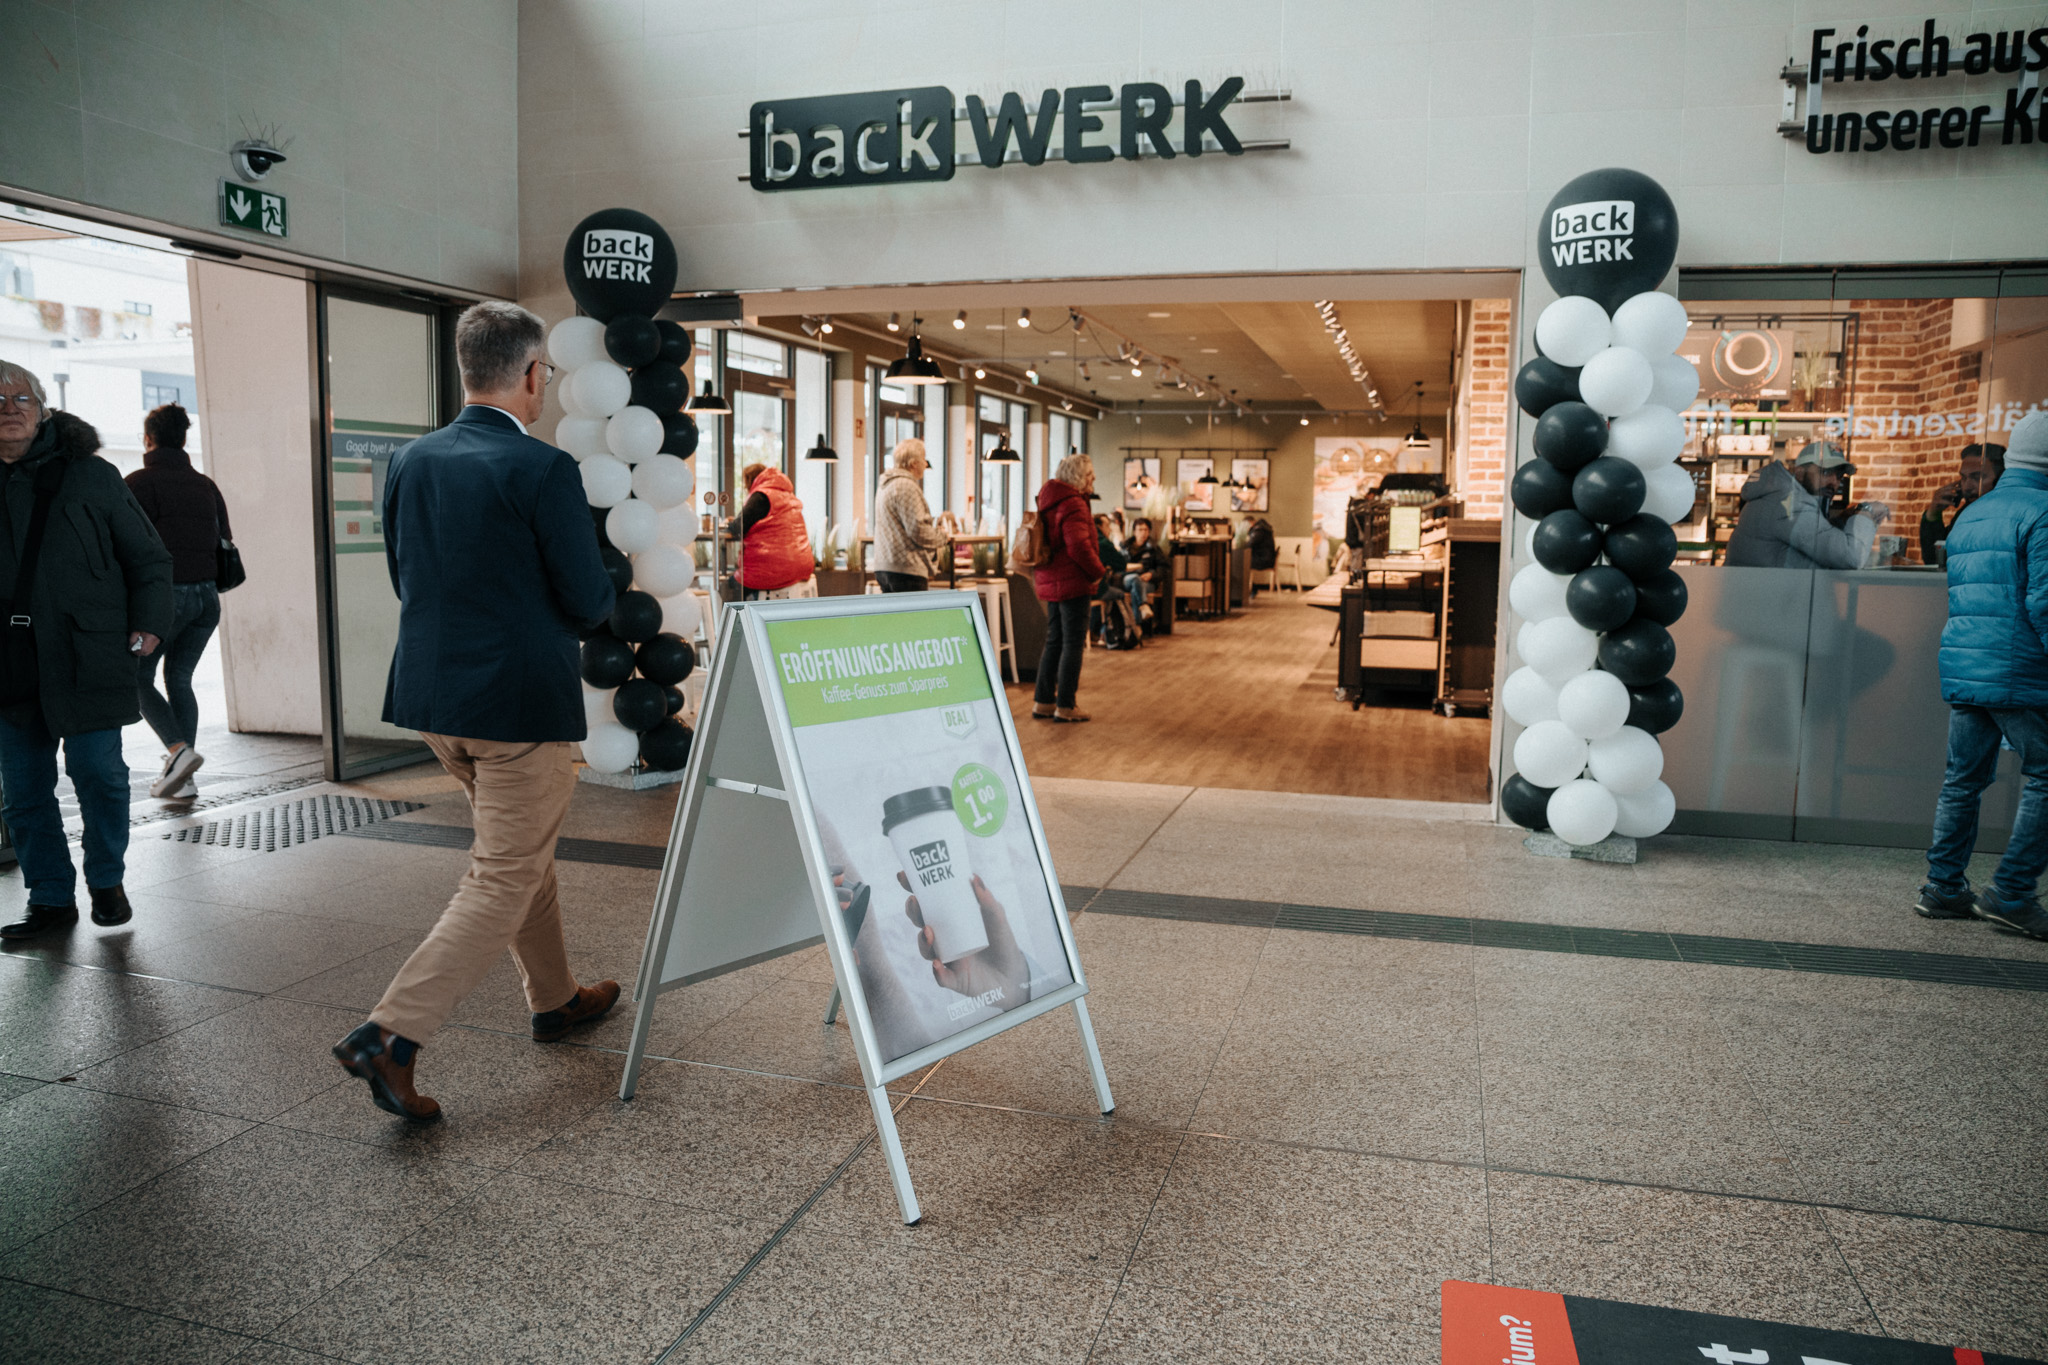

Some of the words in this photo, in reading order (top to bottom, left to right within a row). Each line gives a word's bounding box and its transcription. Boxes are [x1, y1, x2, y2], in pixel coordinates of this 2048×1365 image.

[1810, 19, 1949, 84] Frisch
[1964, 28, 2048, 75] aus
[761, 98, 942, 182] back
[965, 76, 1245, 169] WERK
[1806, 105, 1990, 154] unserer
[1555, 204, 1628, 238] back
[586, 233, 649, 259] back
[1551, 238, 1634, 267] WERK
[583, 260, 652, 284] WERK
[345, 440, 369, 453] Good
[821, 682, 888, 704] Kaffee-Genuss
[888, 679, 908, 695] zum
[907, 673, 949, 694] Sparpreis
[944, 709, 970, 727] DEAL
[911, 842, 949, 869] back
[918, 864, 955, 887] WERK
[950, 998, 976, 1019] back
[973, 987, 1006, 1009] WERK
